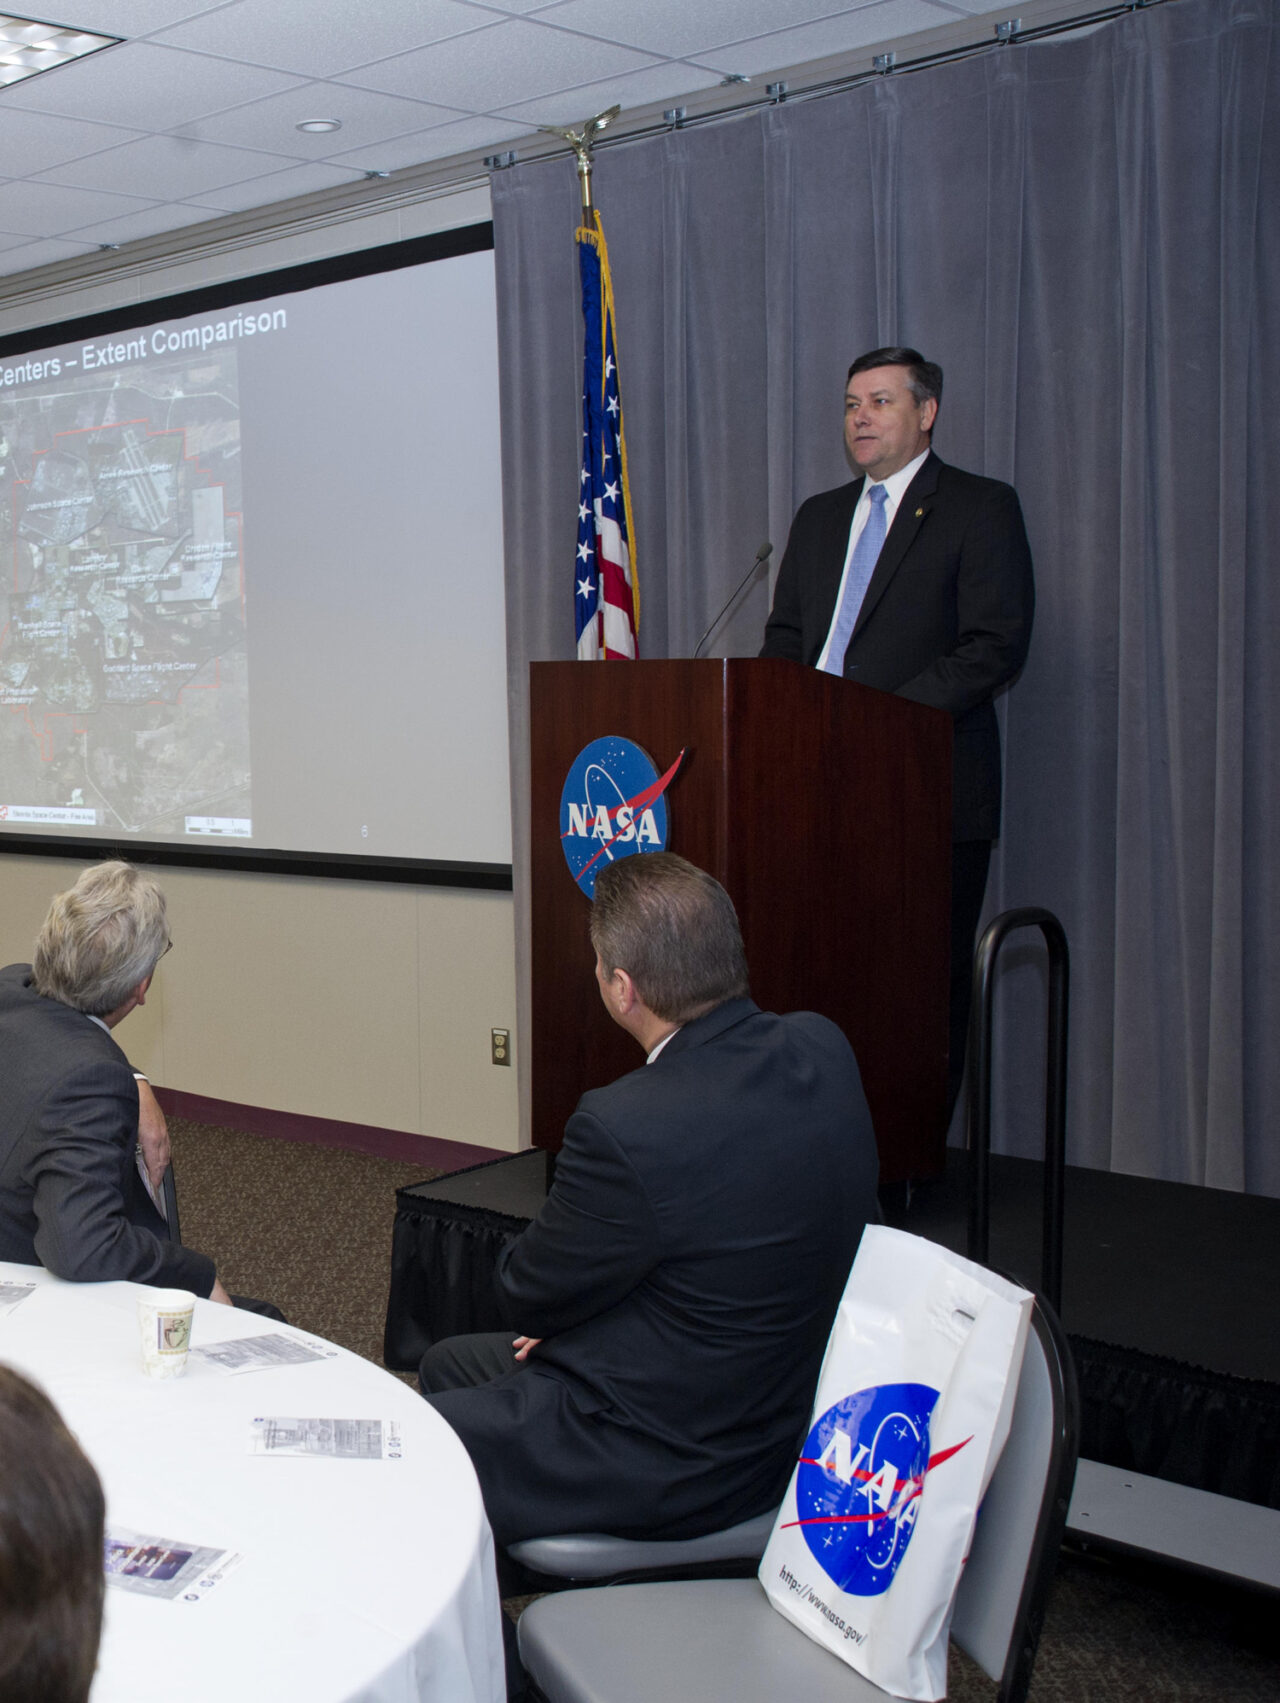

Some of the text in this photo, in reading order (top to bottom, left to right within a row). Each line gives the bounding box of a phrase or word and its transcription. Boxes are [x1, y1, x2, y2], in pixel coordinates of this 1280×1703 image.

[82, 334, 147, 370] Extent
[151, 308, 287, 354] Comparison
[567, 803, 662, 844] NASA
[814, 1427, 920, 1530] NASA
